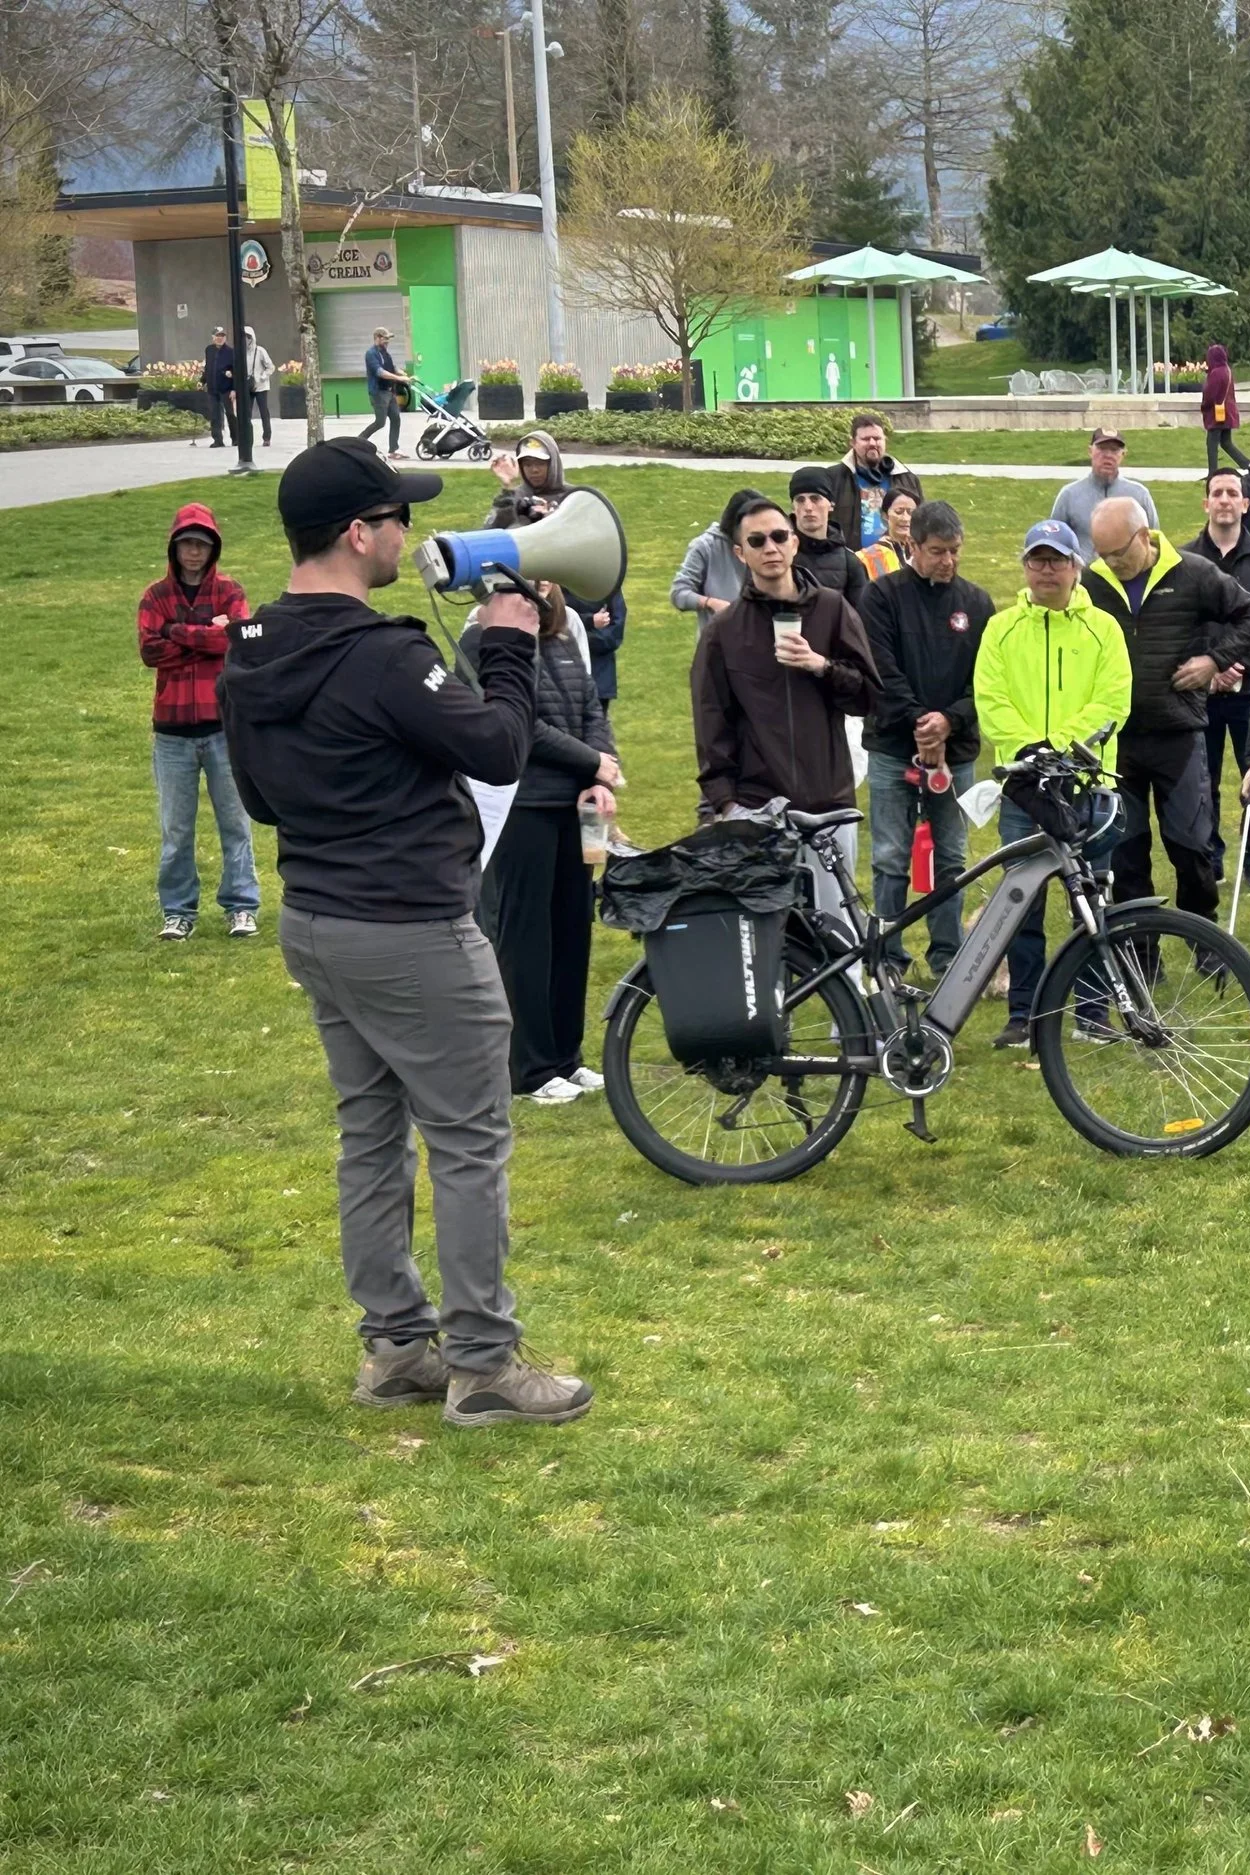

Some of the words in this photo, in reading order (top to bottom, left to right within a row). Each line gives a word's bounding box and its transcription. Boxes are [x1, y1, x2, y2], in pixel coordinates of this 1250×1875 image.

[338, 249, 360, 262] ICE
[328, 265, 371, 279] CREAM
[241, 623, 263, 639] HH
[423, 664, 447, 692] HH
